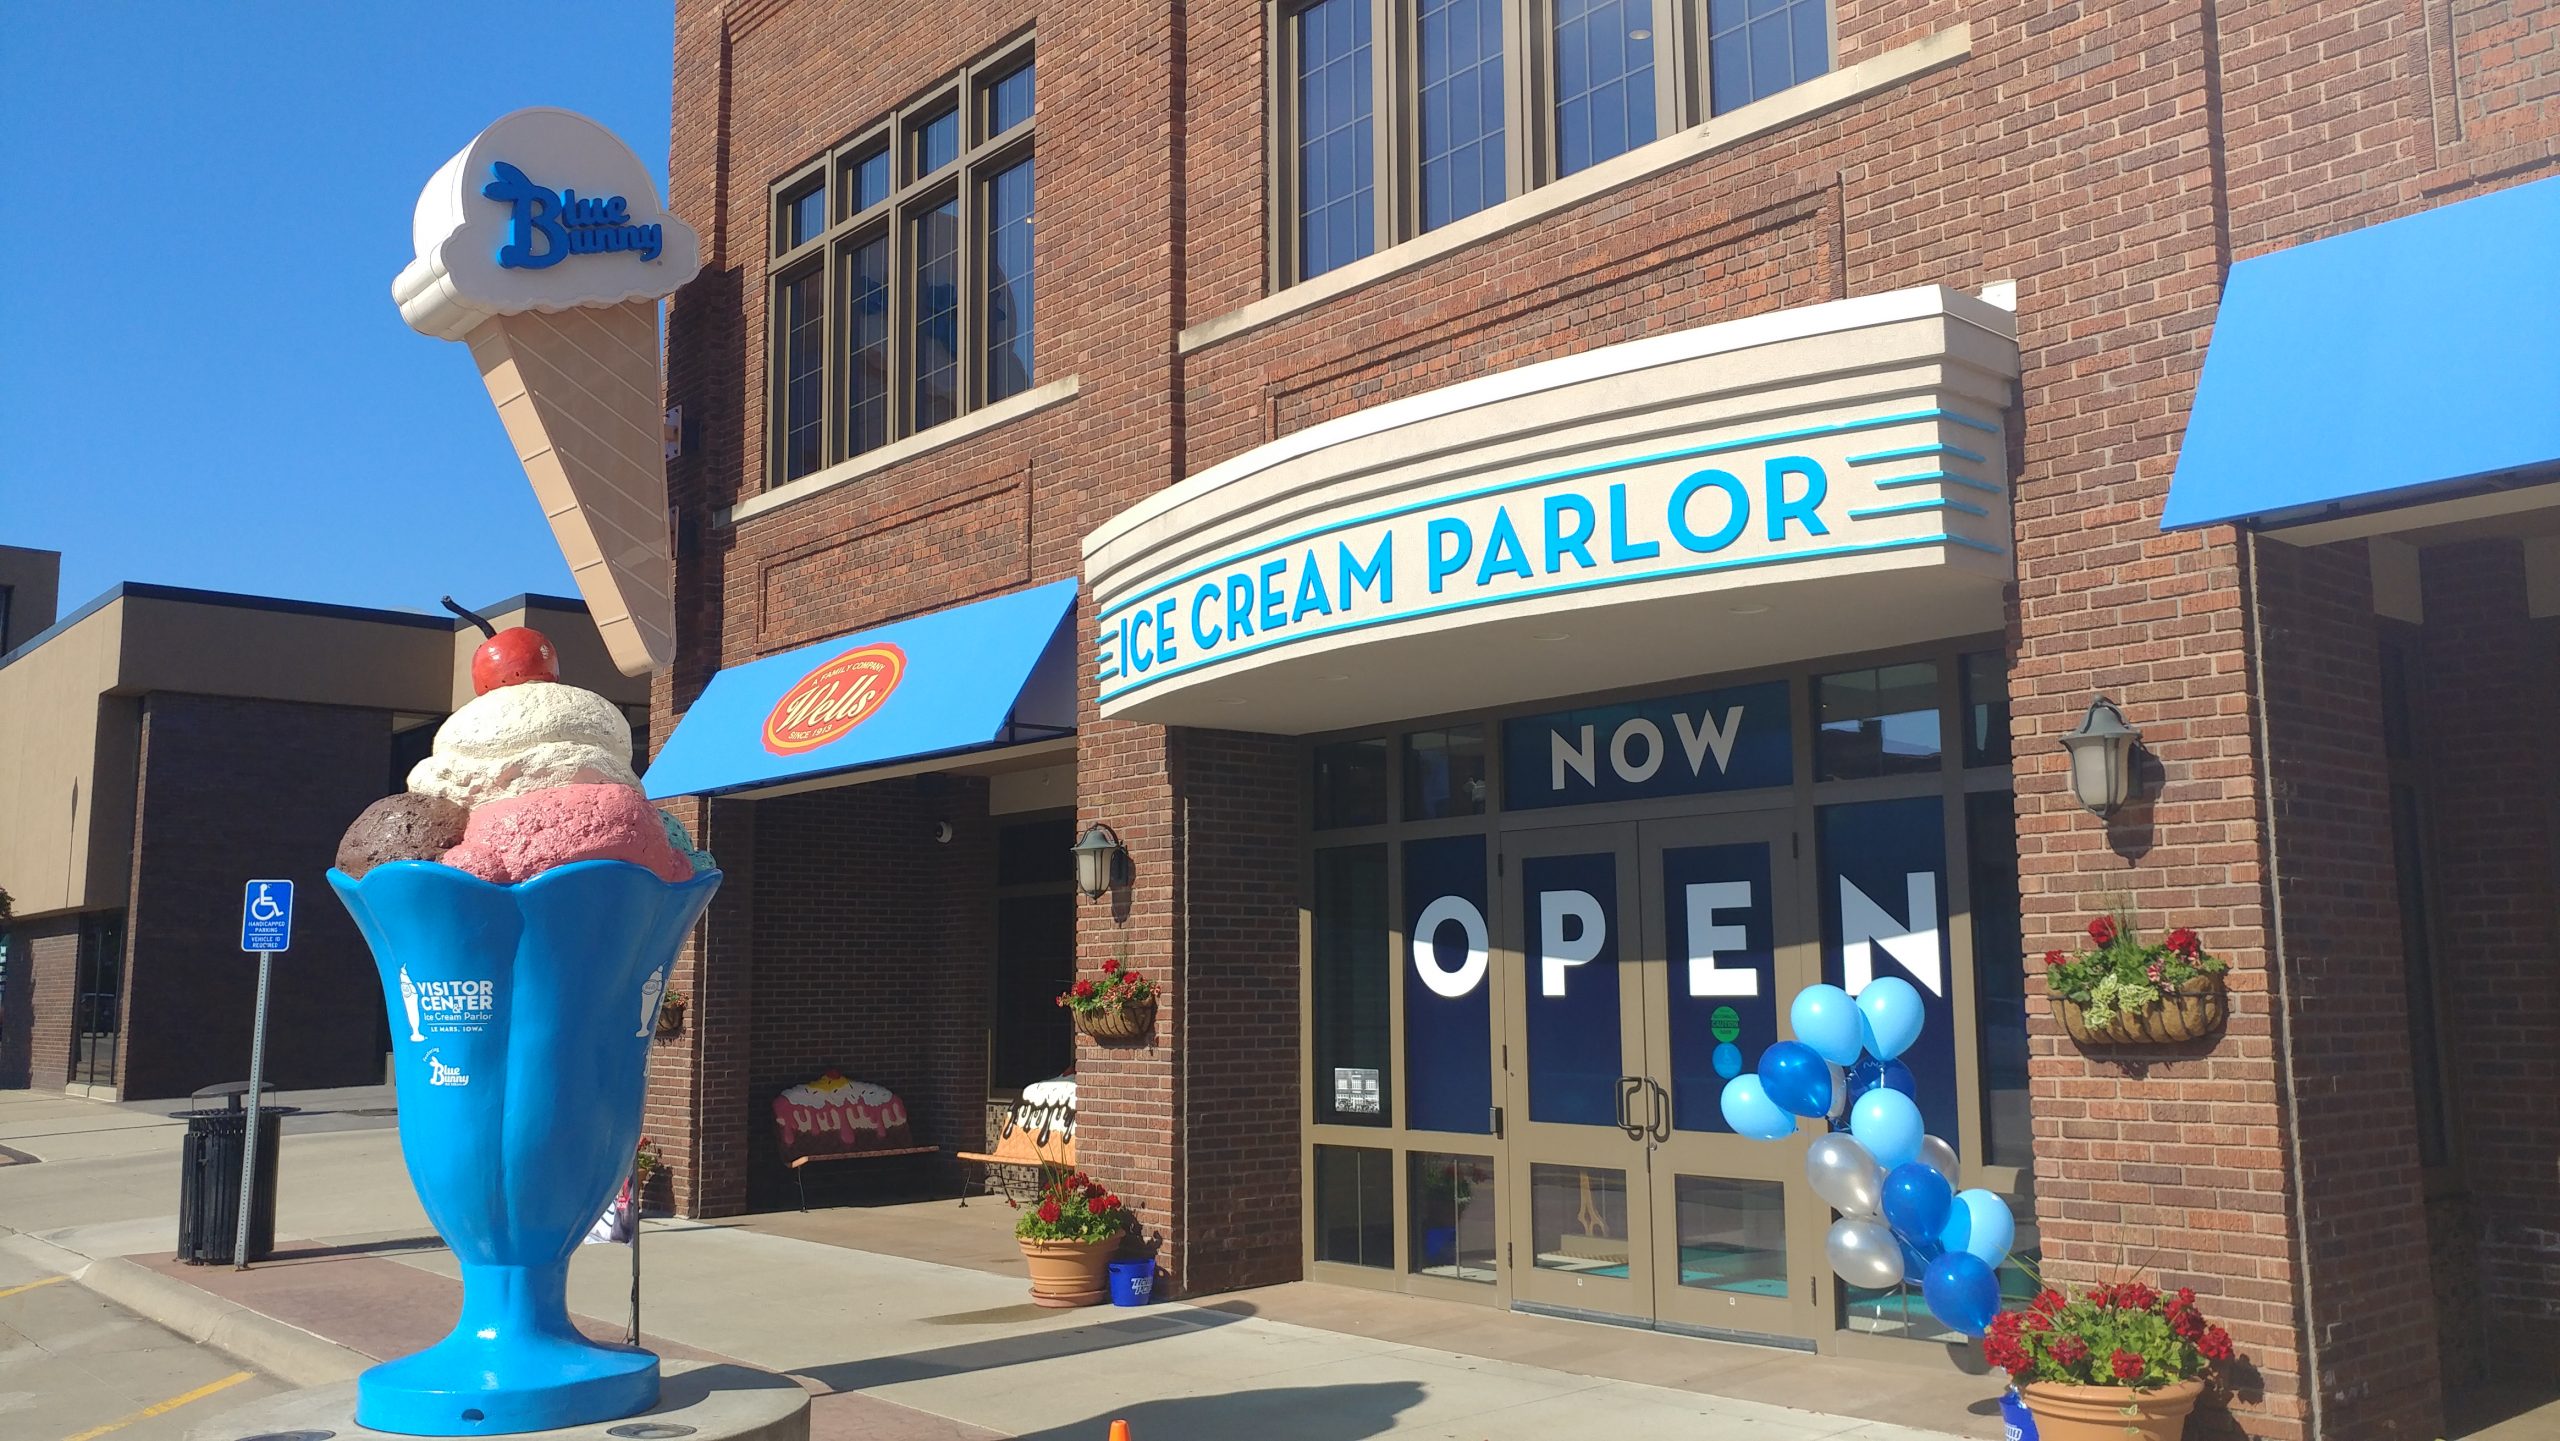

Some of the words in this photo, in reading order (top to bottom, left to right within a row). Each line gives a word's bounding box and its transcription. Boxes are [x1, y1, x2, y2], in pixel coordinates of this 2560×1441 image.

[1120, 597, 1177, 677] ICE
[1191, 529, 1393, 650] CREAM
[1427, 455, 1830, 594] PARLOR
[811, 678, 818, 687] A
[820, 664, 851, 682] FAMILY
[852, 661, 886, 672] COMPANY
[775, 674, 879, 734] Wells
[788, 730, 811, 740] SINCE
[812, 724, 833, 738] 1913
[1551, 705, 1744, 791] NOW
[1413, 871, 1942, 998] OPEN
[417, 980, 494, 996] VISITOR
[421, 995, 493, 1011] CENTER
[423, 1012, 434, 1021] Ice
[434, 1012, 462, 1021] Cream
[464, 1011, 493, 1021] Parlor
